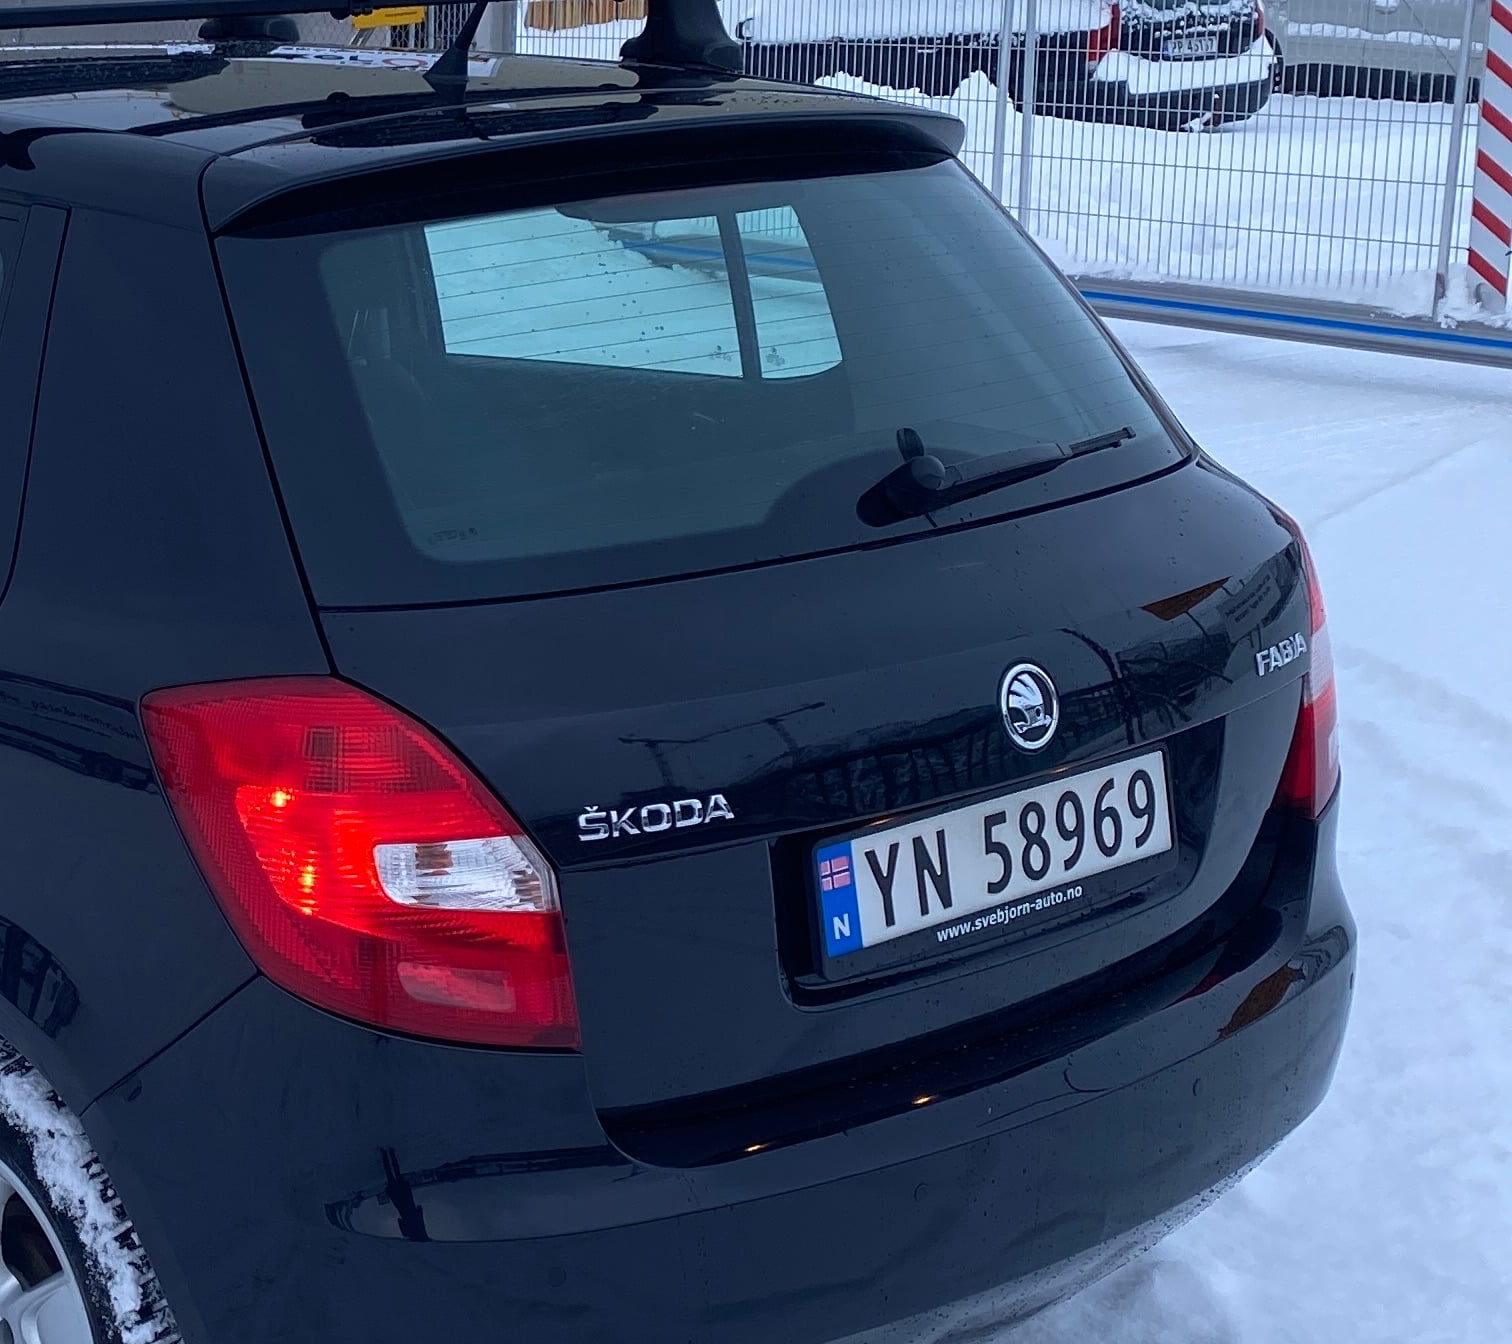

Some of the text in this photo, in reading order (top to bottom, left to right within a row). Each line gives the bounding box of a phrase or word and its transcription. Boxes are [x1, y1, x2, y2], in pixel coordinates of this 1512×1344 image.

[1255, 632, 1308, 676] FABIA
[578, 794, 735, 841] ŠKODA
[865, 769, 1155, 927] YN 58969
[832, 913, 850, 939] N
[937, 885, 1083, 942] www.svebjorn-auto.no
